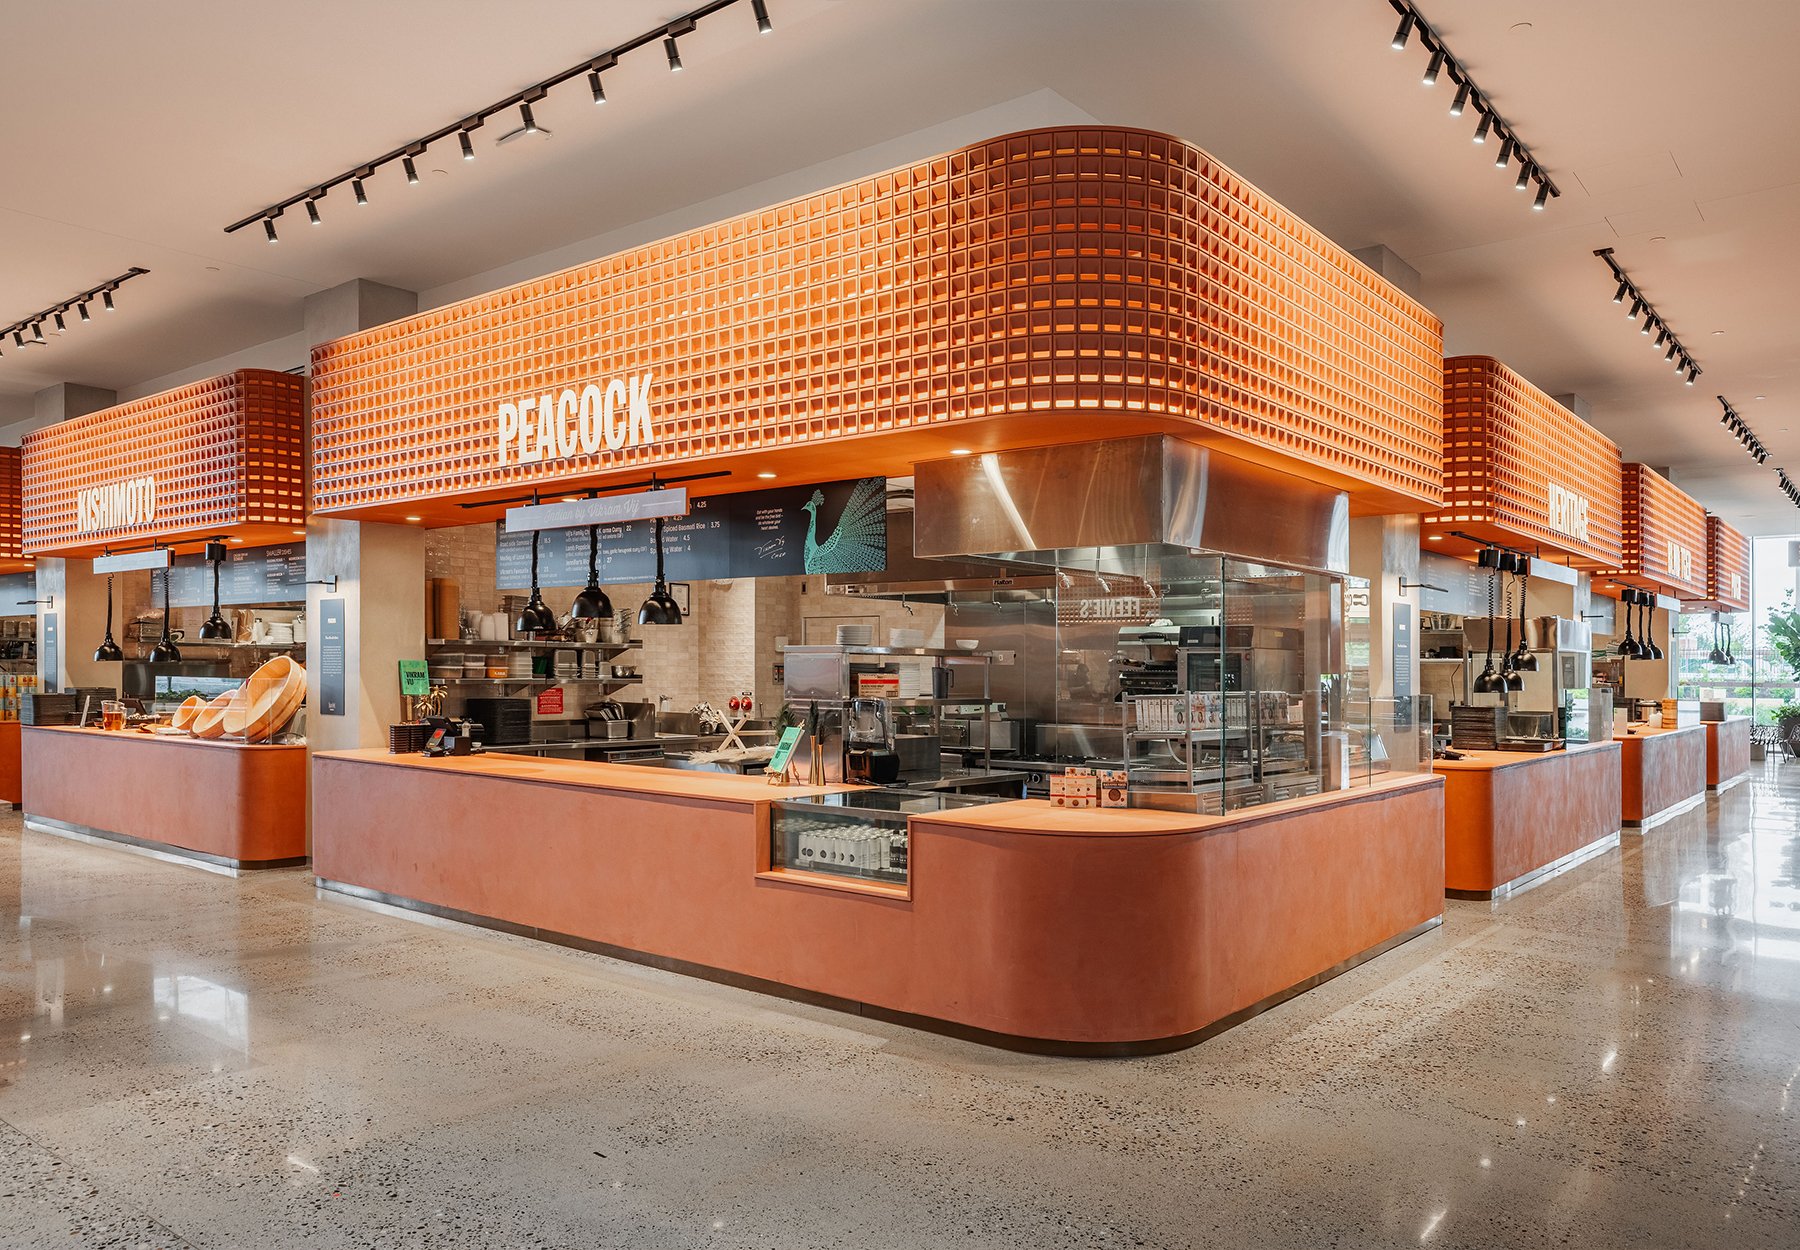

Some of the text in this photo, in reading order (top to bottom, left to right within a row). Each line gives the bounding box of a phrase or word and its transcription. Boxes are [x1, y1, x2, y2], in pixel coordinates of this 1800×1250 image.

[498, 373, 654, 466] PEACOCK
[78, 476, 155, 533] KISHIMOTO
[544, 500, 640, 523] Indian by Vikram Vij
[1549, 482, 1589, 542] HERITAGE
